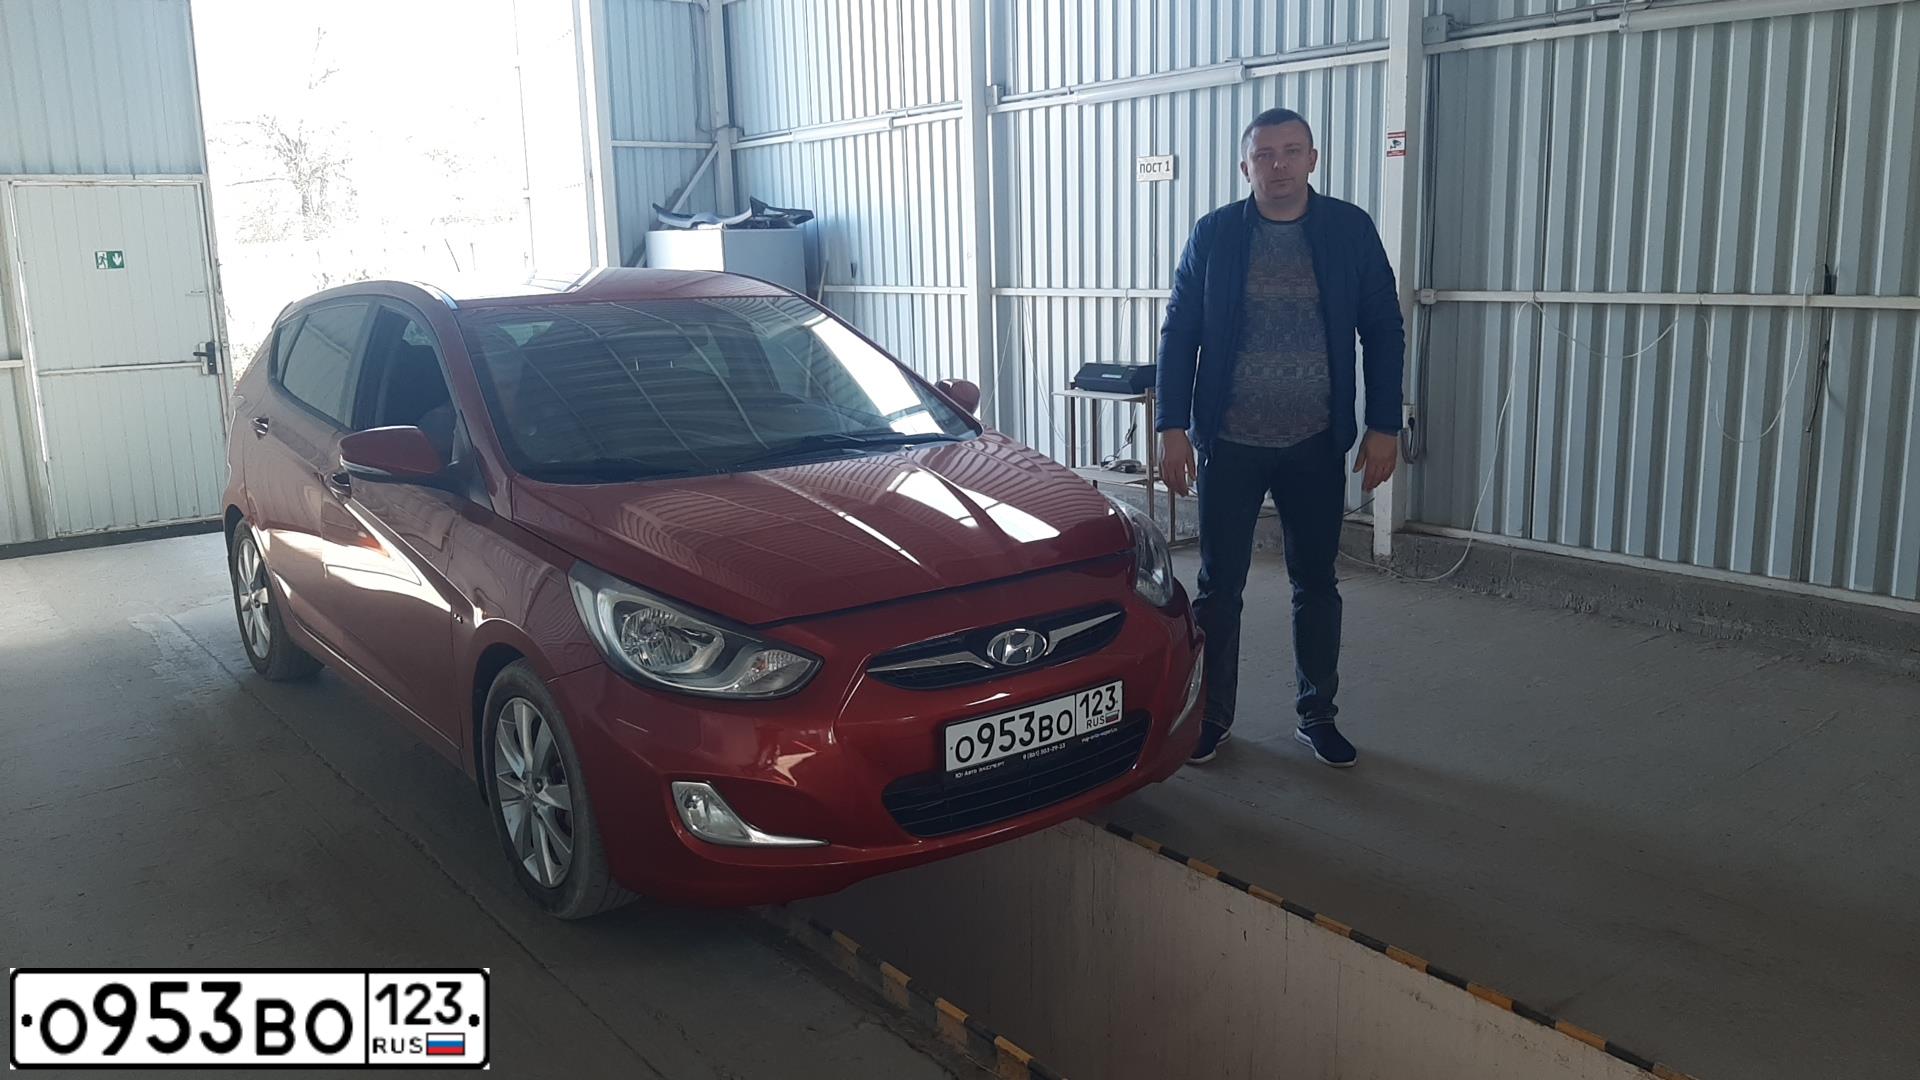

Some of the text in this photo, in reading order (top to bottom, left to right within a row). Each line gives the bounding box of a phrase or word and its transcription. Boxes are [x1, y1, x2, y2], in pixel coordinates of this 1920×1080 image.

[1140, 160, 1170, 174] ПОСТ 1
[1079, 685, 1116, 719] 123
[1086, 715, 1105, 730] RUS
